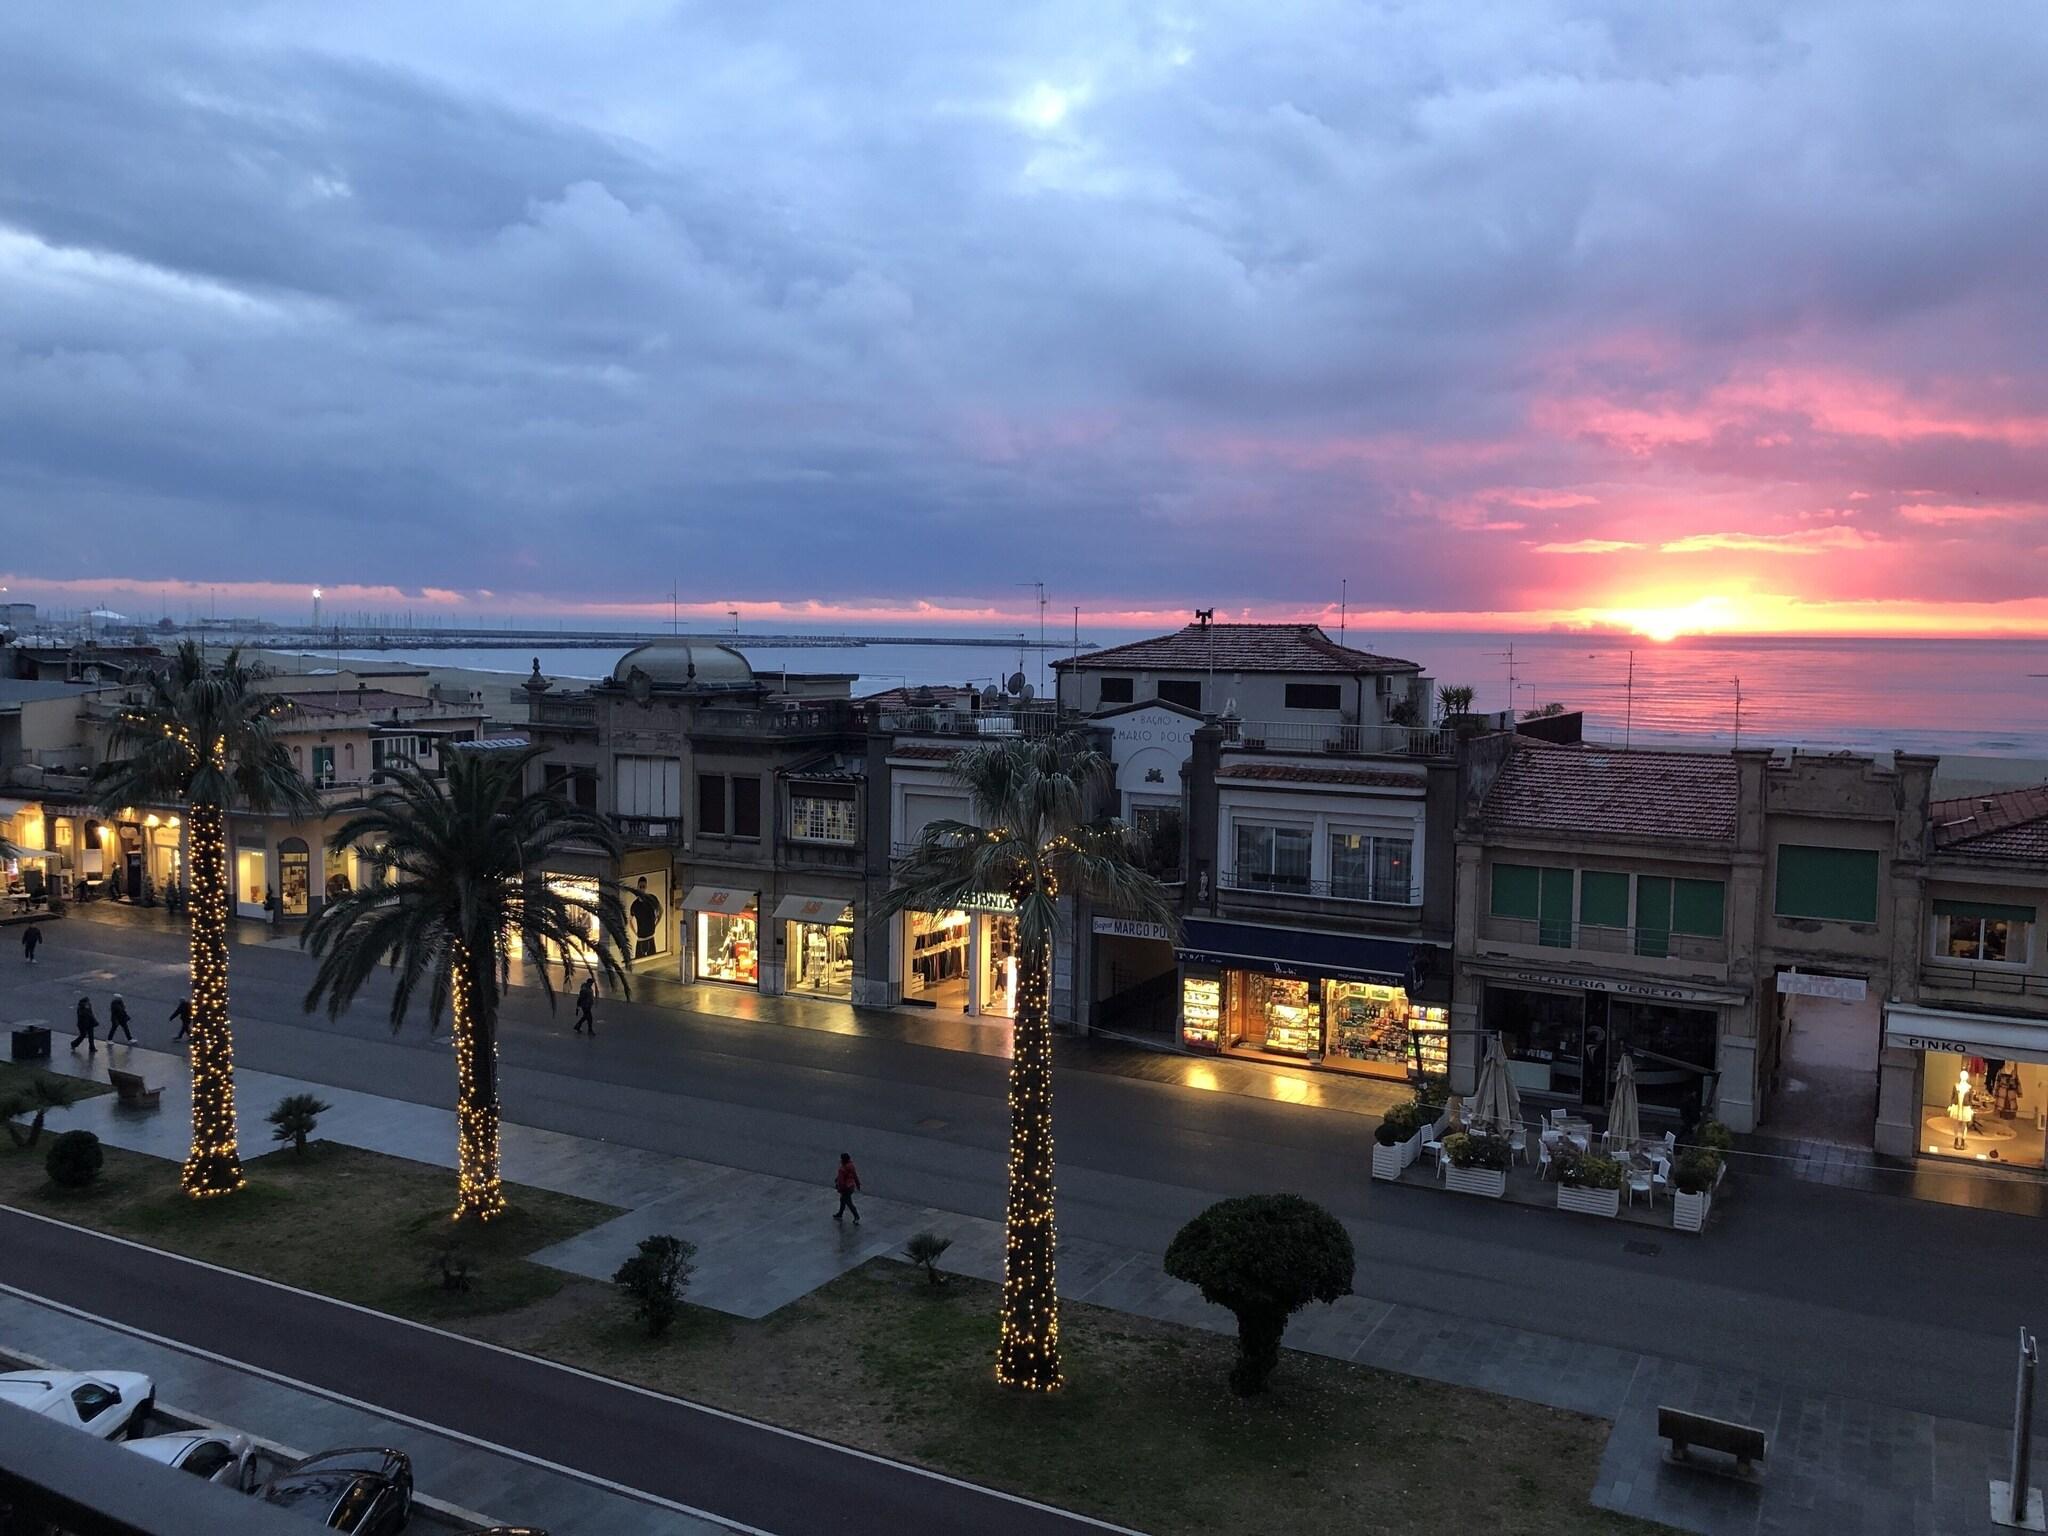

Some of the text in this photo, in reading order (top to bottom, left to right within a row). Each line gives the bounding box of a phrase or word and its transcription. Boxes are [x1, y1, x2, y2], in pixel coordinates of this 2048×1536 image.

[1118, 730, 1192, 744] MARCO POLO
[960, 892, 1014, 910] EDONIA
[1114, 920, 1150, 937] MARCO
[1153, 924, 1167, 938] PO
[1518, 973, 1682, 998] GELATERIA VENETA
[1909, 1038, 1966, 1053] PINKO
